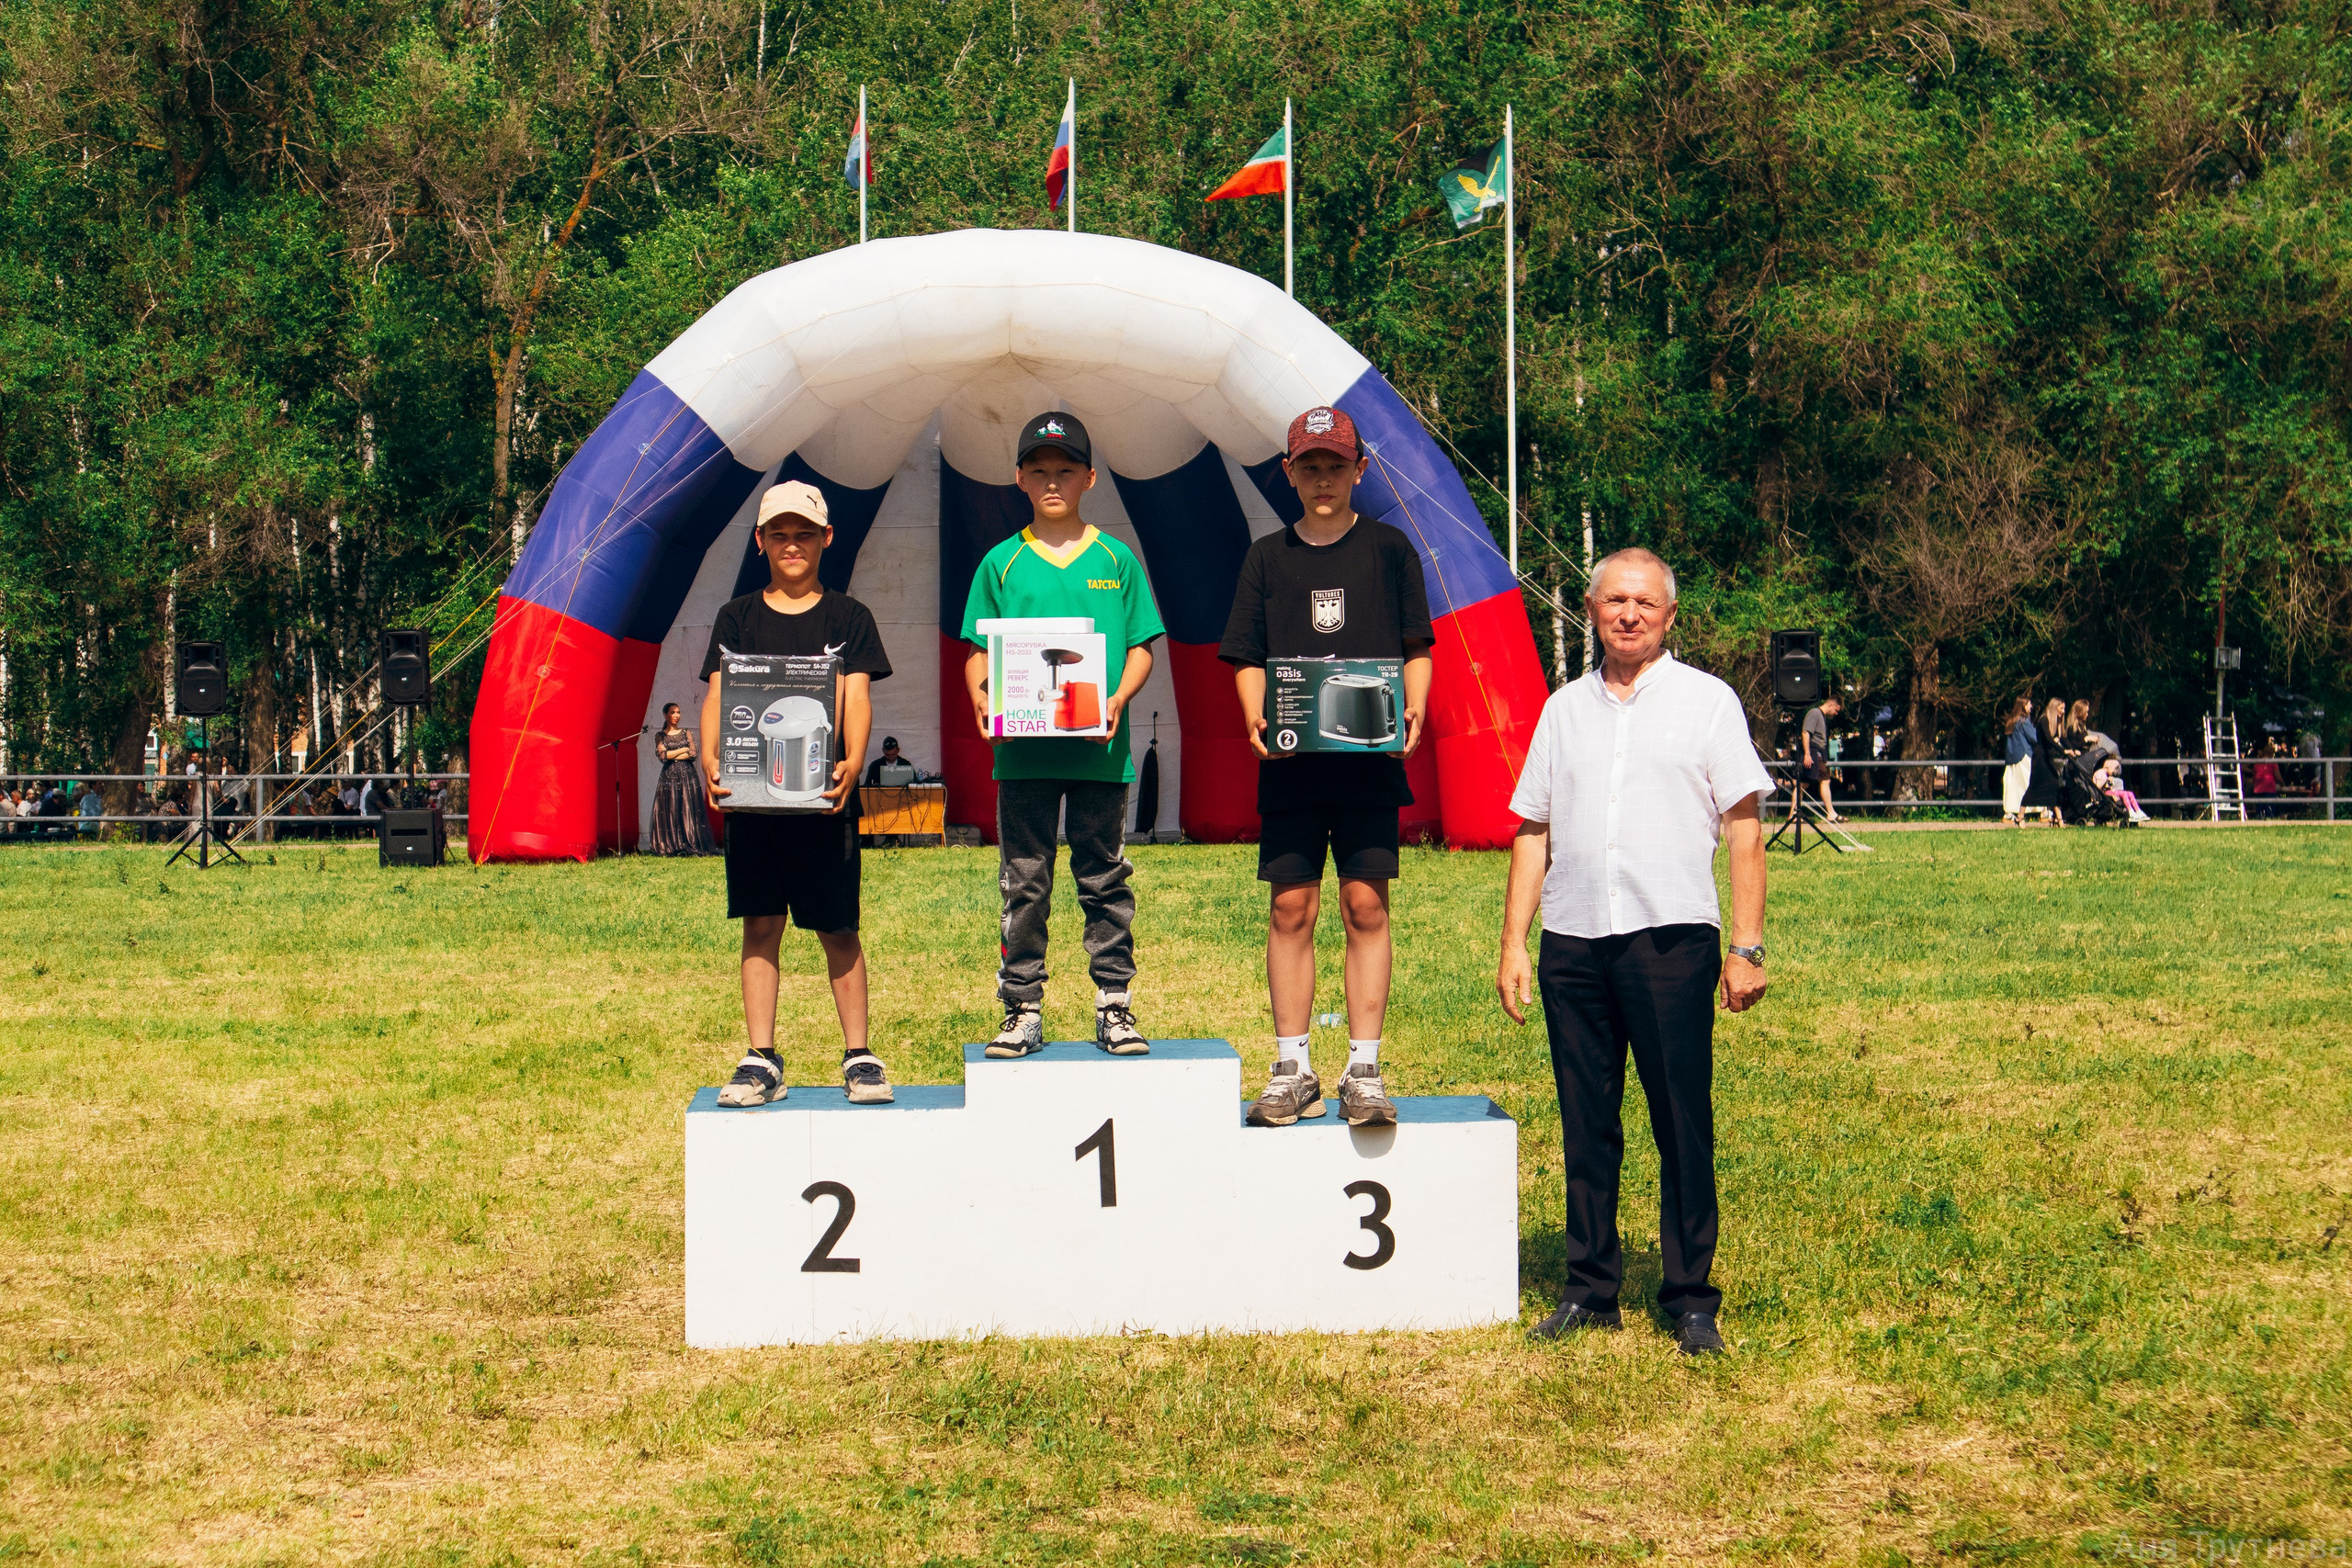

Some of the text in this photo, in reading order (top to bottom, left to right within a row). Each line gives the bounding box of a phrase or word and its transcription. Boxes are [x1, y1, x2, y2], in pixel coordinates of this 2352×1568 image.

[1276, 669, 1302, 678] oasis
[733, 711, 746, 719] 750
[1006, 709, 1046, 720] HOME
[1006, 721, 1046, 733] STAR
[726, 737, 741, 747] 3.0
[1283, 733, 1291, 743] 2
[1076, 1119, 1116, 1207] 1
[801, 1181, 860, 1272] 2
[1343, 1180, 1395, 1269] 3
